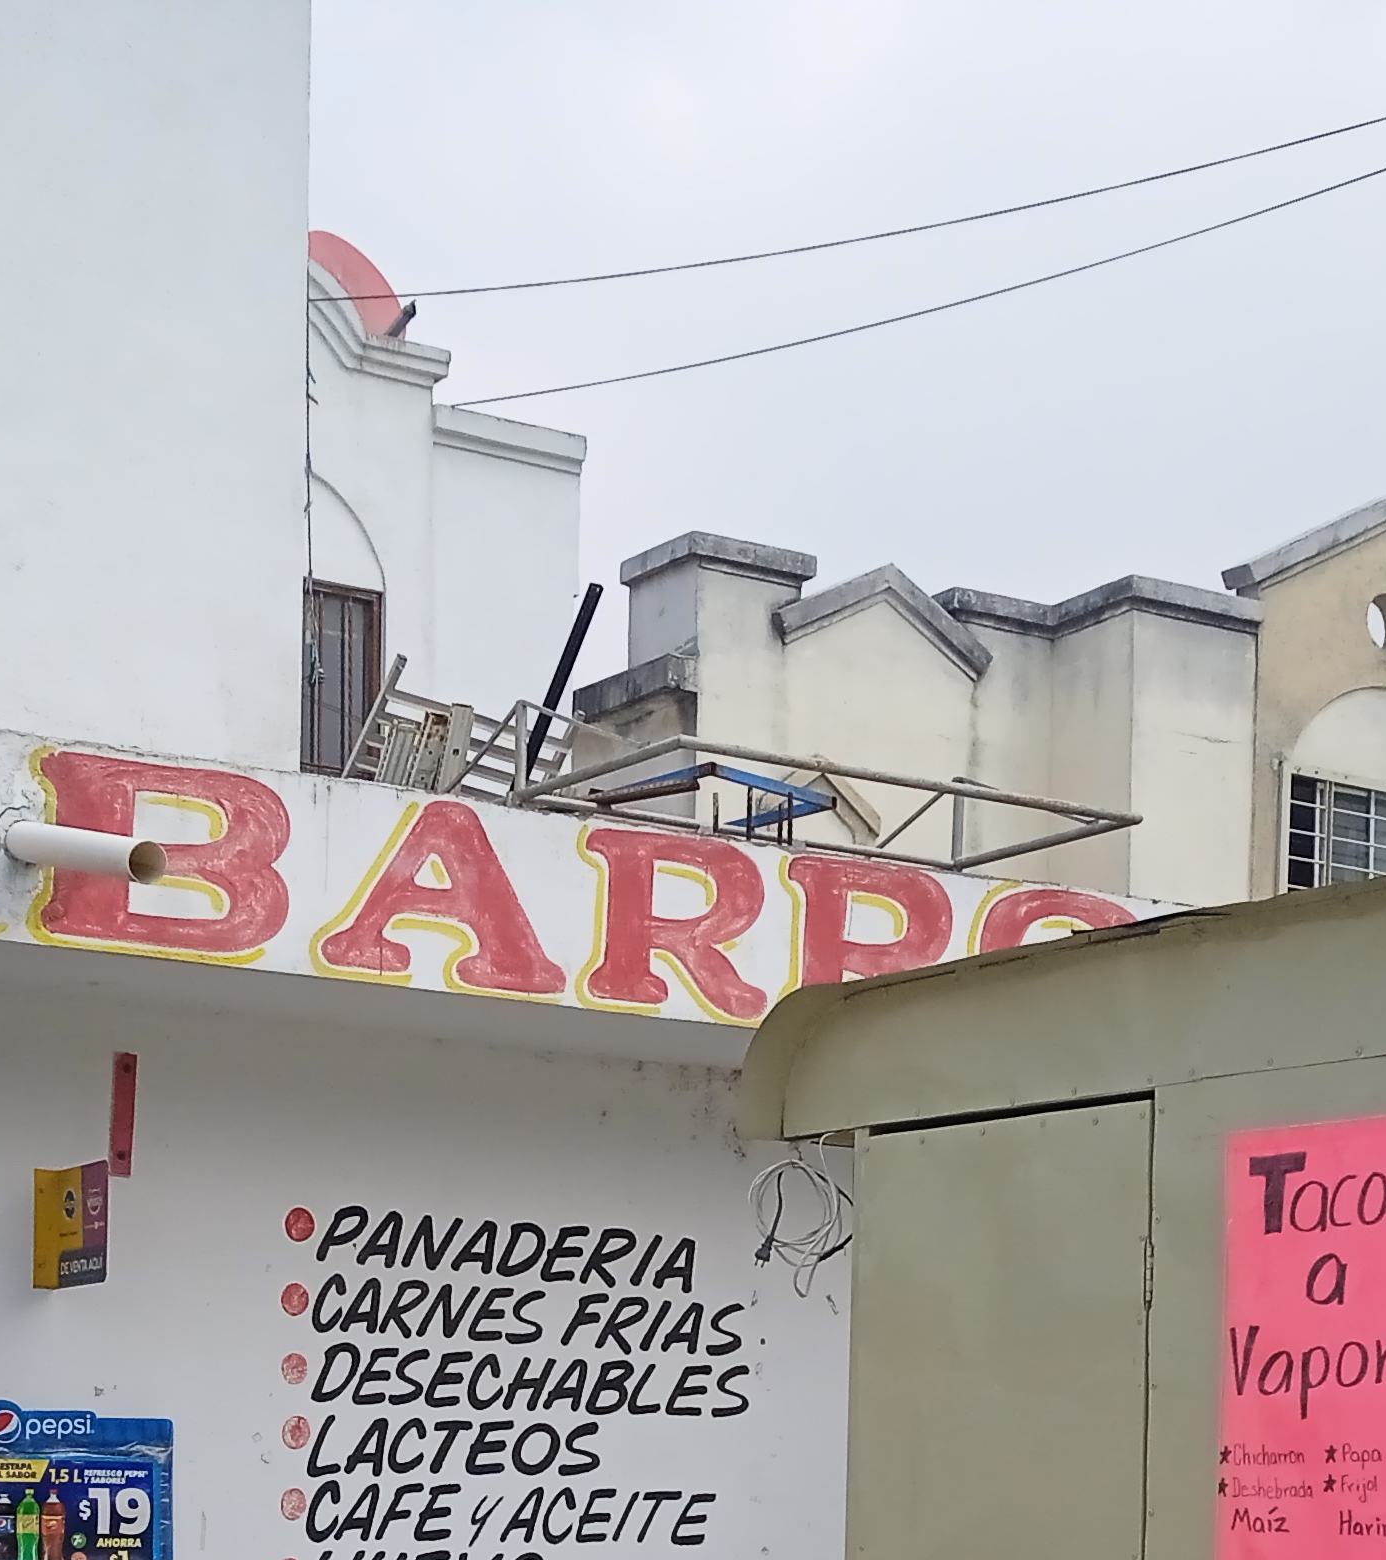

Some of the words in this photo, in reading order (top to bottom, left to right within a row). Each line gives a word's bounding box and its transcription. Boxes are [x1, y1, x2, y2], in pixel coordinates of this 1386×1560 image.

[315, 1205, 696, 1294] PANADERIA
[1305, 1252, 1349, 1306] a
[312, 1274, 546, 1344] CARNES
[560, 1292, 746, 1357] FRIAS
[310, 1342, 751, 1418] DESECHABLES
[25, 1414, 95, 1440] pepsi
[306, 1414, 601, 1479] LACTEOS
[5, 1470, 37, 1479] SABOR
[1341, 1442, 1383, 1470] Papa
[48, 1468, 70, 1485] 1,5
[73, 1469, 82, 1483] L
[1231, 1476, 1314, 1500] Deshebrada
[1339, 1474, 1378, 1504] Frijol
[78, 1487, 152, 1536] $19
[305, 1480, 462, 1545] CAFE
[499, 1486, 717, 1547] ACEITE
[1230, 1506, 1291, 1535] Maíz
[96, 1537, 143, 1549] AHORRA
